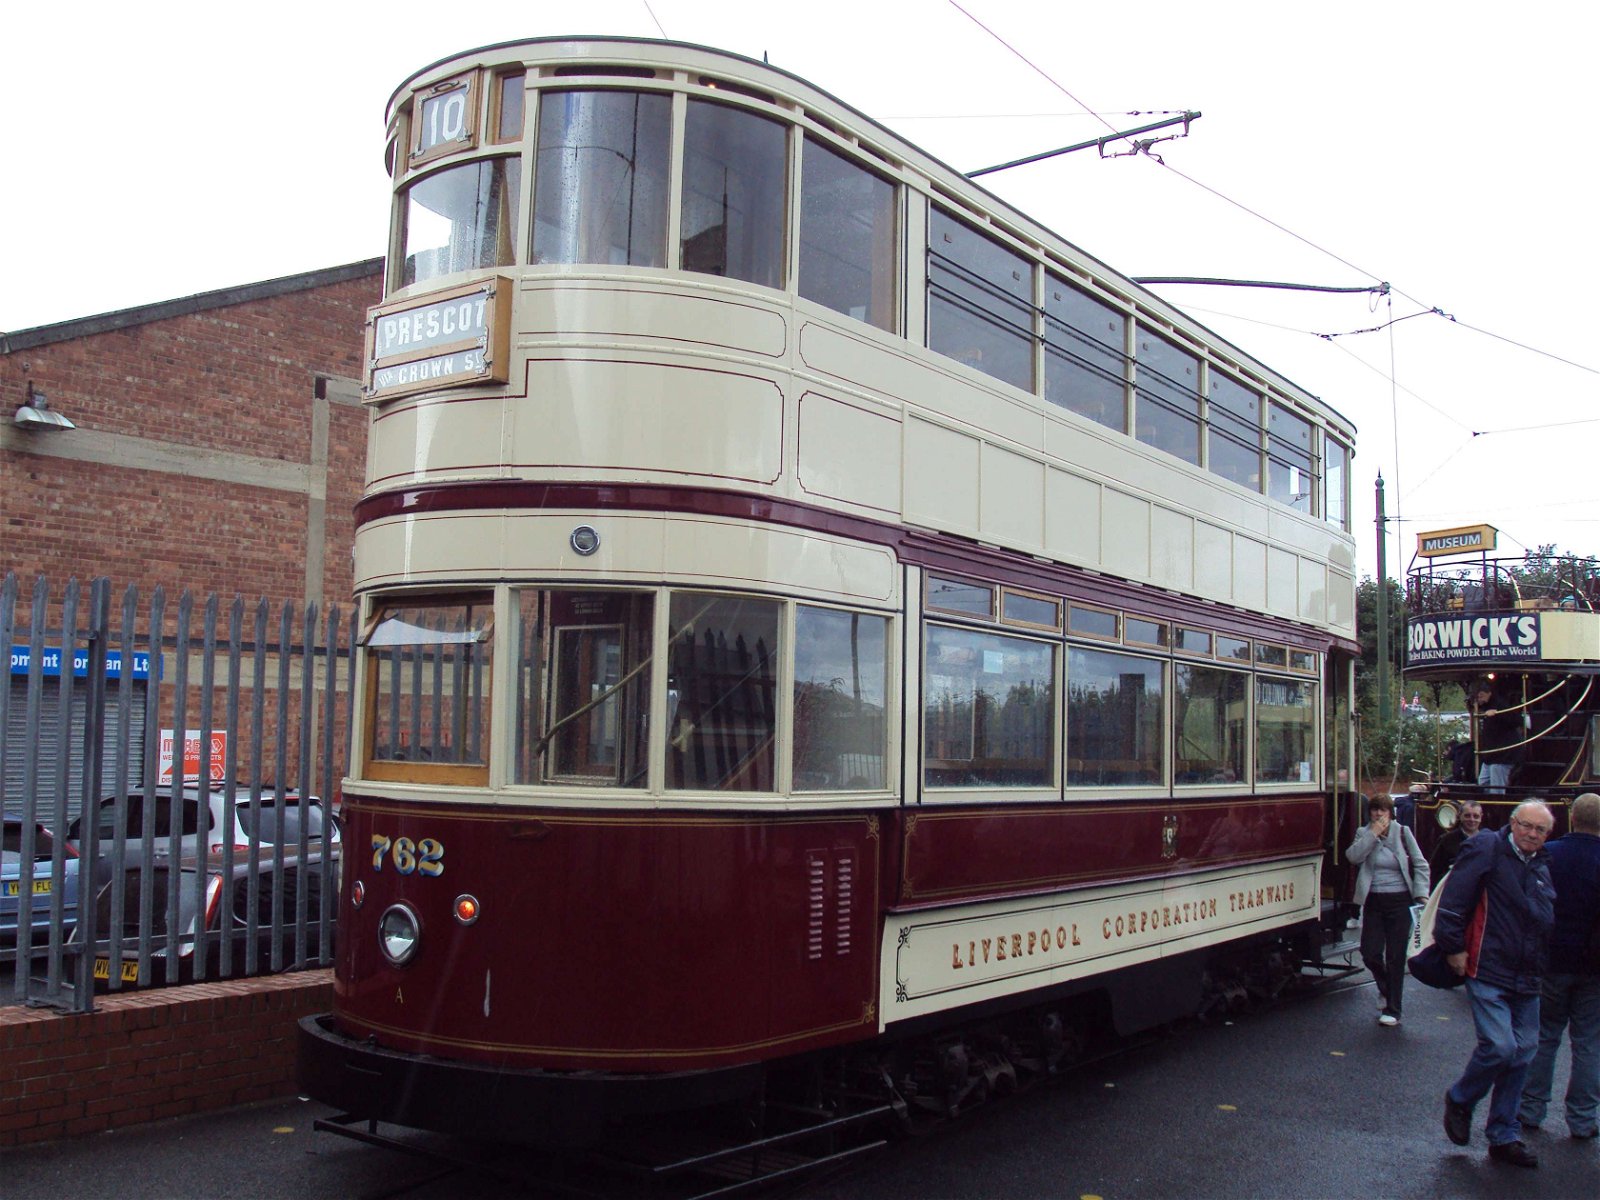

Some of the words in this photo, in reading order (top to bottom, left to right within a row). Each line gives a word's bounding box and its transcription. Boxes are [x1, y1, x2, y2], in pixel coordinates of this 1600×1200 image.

[430, 93, 466, 147] 10
[384, 299, 487, 349] PRESCOT
[398, 358, 454, 385] CROWN
[1426, 534, 1481, 551] MUSEUM
[1408, 616, 1538, 651] BORWICK'S
[133, 657, 150, 672] Lt
[1446, 648, 1480, 659] POWDER
[1481, 647, 1490, 657] in
[1491, 647, 1508, 656] The
[1508, 647, 1537, 656] World
[371, 834, 444, 877] 762
[952, 923, 1081, 969] LIVERPOOL
[1103, 898, 1217, 939] CORPORATION
[1229, 882, 1295, 912] TRAMWAYS
